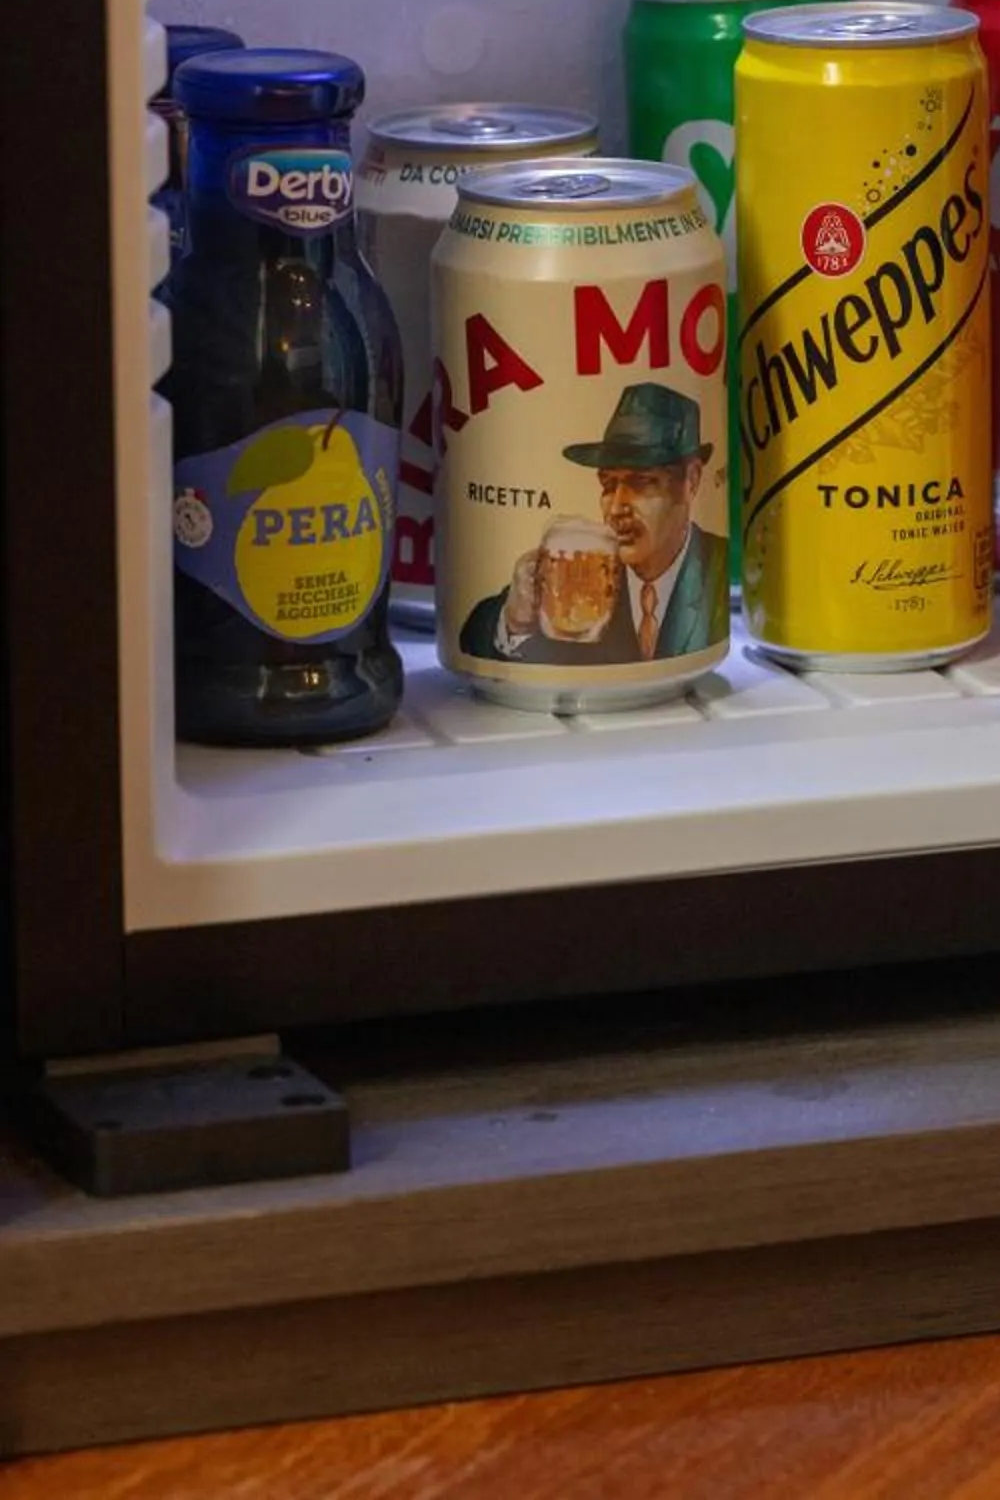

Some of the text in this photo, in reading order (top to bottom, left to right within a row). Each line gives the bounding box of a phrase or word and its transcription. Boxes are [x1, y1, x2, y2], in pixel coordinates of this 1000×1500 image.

[247, 161, 352, 206] Derby
[284, 208, 331, 223] blue
[498, 215, 681, 246] PREFERIBILMENTE
[469, 482, 551, 509] RICETTA
[817, 477, 965, 510] TONICA
[252, 497, 377, 546] PERA
[915, 505, 964, 522] ORIGINAL
[892, 521, 965, 541] TONIC WATER
[294, 570, 347, 590] SENZA
[277, 582, 360, 606] ZUCCHERI
[275, 598, 357, 621] AGGIUNTI
